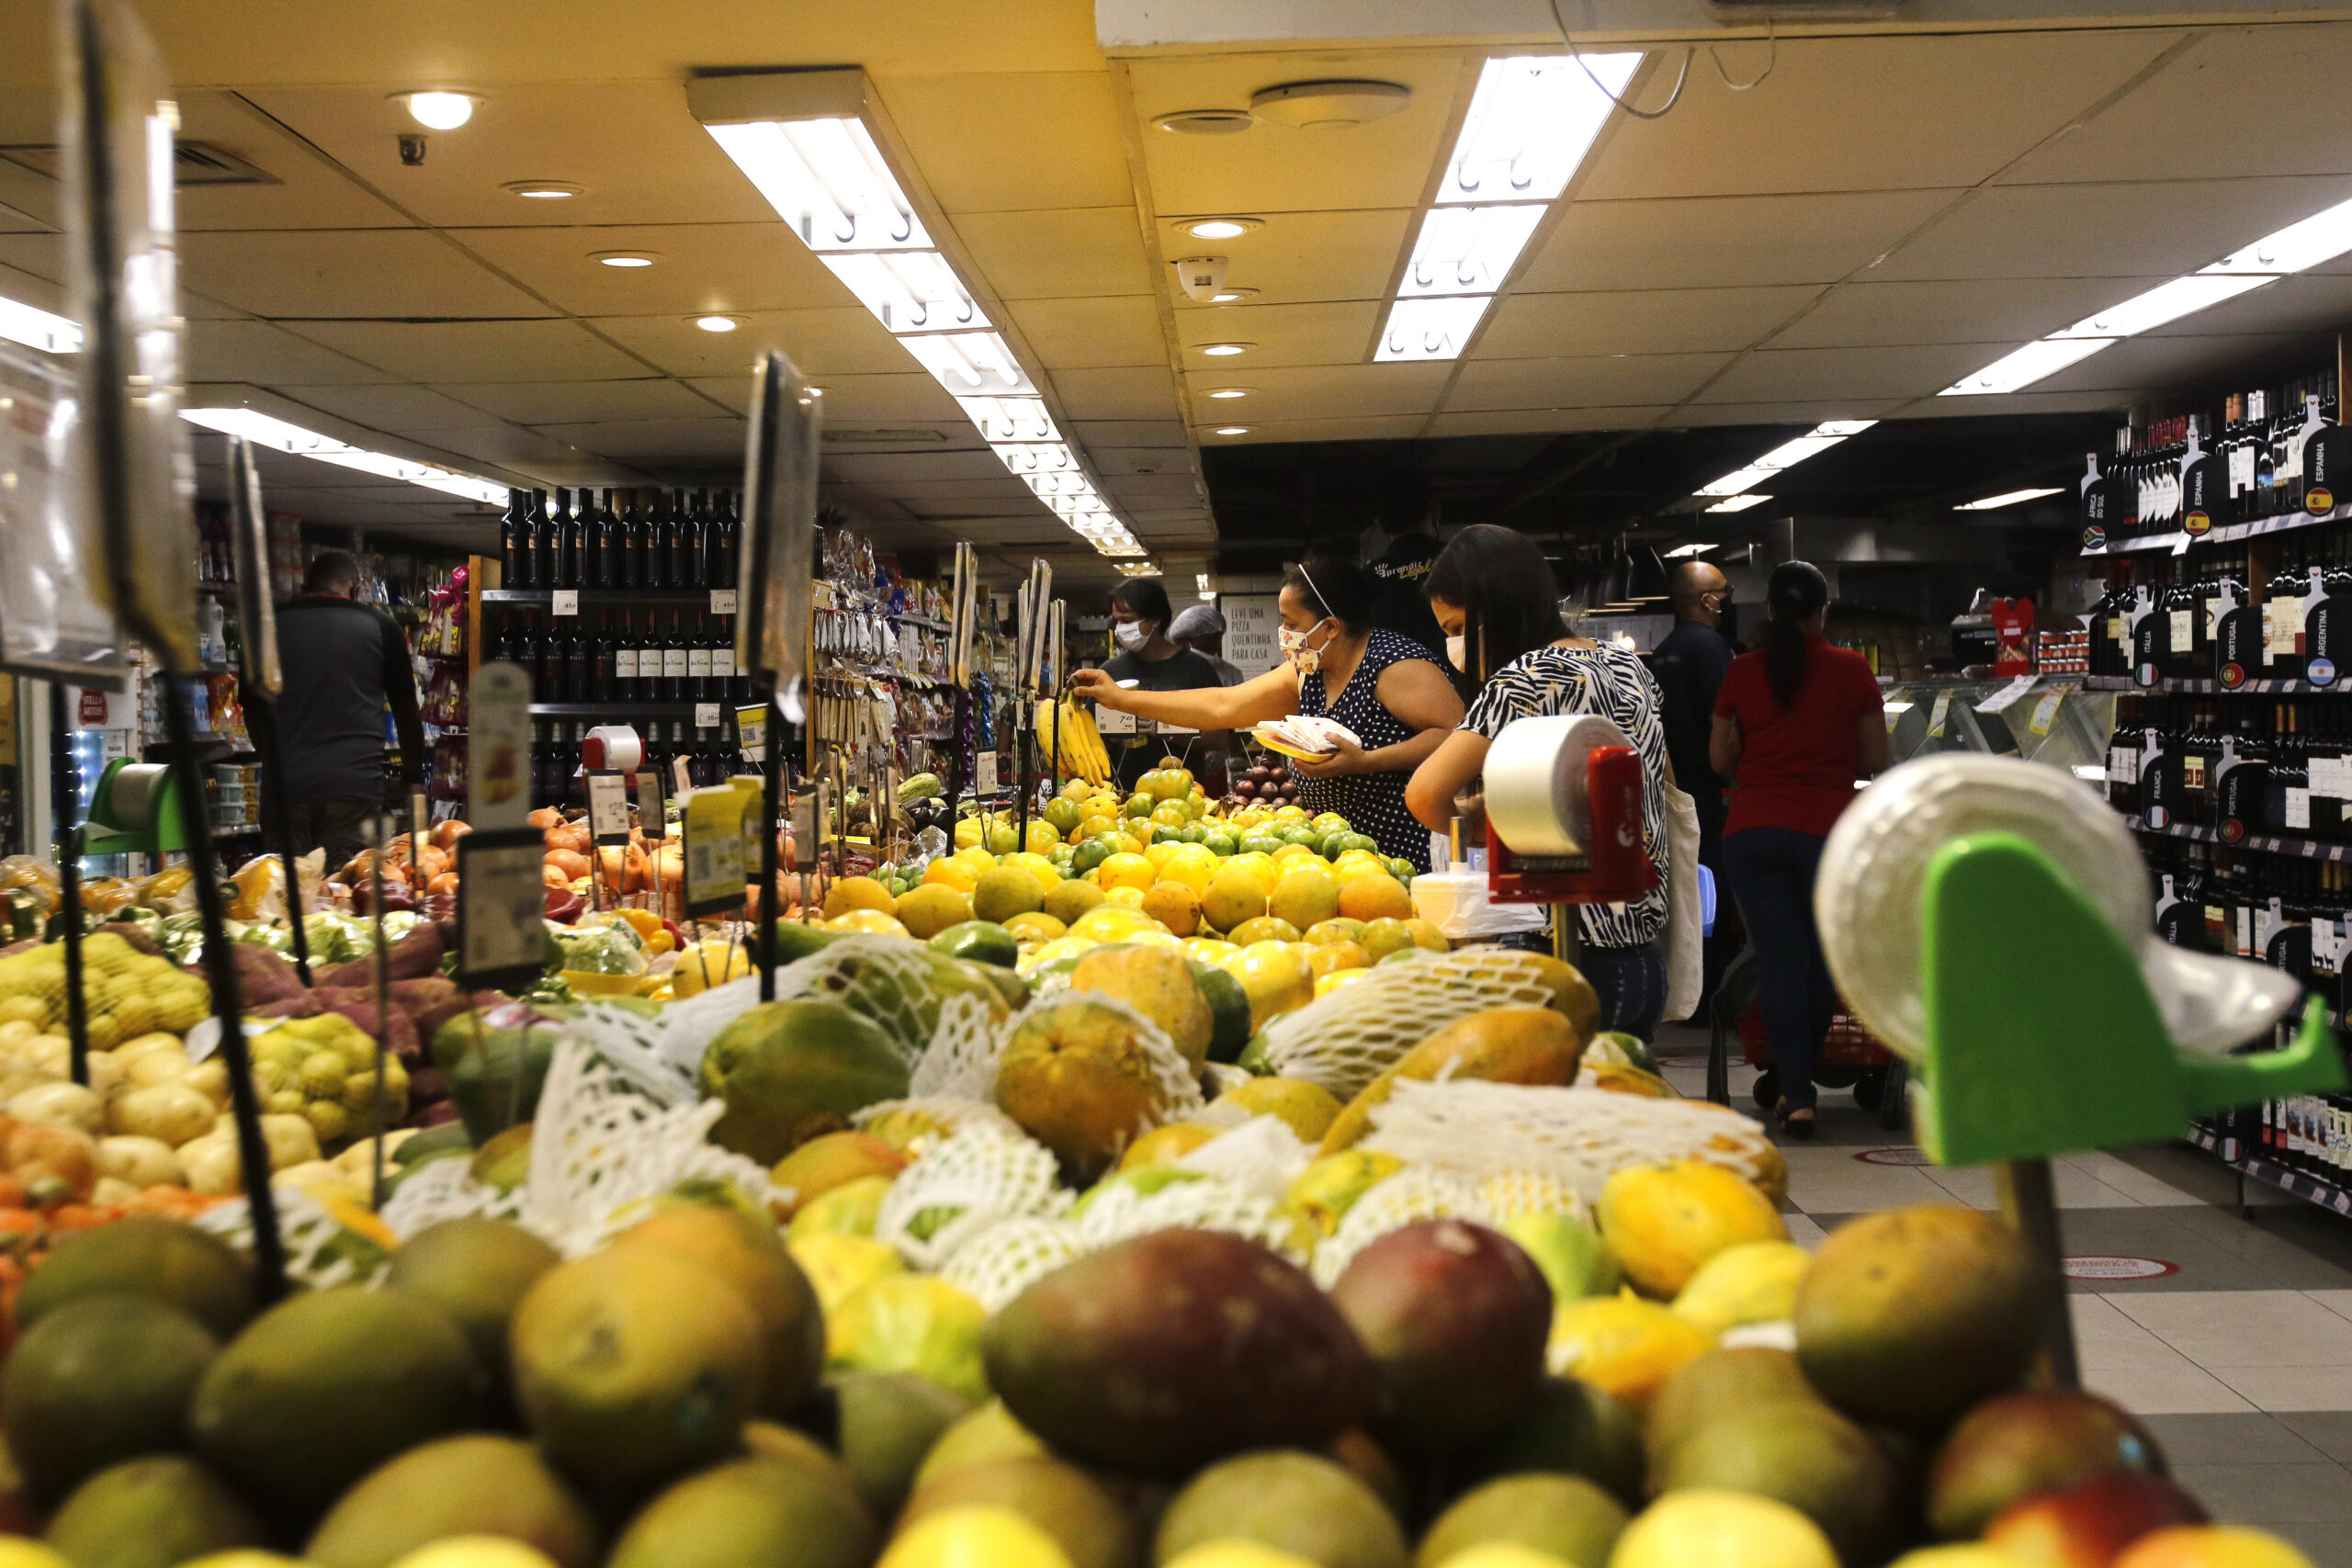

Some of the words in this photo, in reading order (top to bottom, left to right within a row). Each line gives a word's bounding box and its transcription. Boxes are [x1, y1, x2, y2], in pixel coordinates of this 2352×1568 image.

[2315, 442, 2324, 482] ESPANHA
[2194, 470, 2203, 506] ESPANHA
[2097, 509, 2104, 518] DO
[1231, 608, 1247, 619] LEVE
[1250, 607, 1264, 619] UMA
[1231, 621, 1250, 632] PIZZA
[2317, 609, 2327, 657] ARGENTINA
[1231, 634, 1272, 648] QUENTINHA
[2228, 620, 2236, 660] PORTUGAL
[1232, 649, 1249, 660] PARA
[1250, 649, 1268, 660] CASA
[83, 694, 103, 705] STELLA
[2228, 775, 2238, 816] PORTUGAL
[2278, 940, 2287, 974] ORTUGAL
